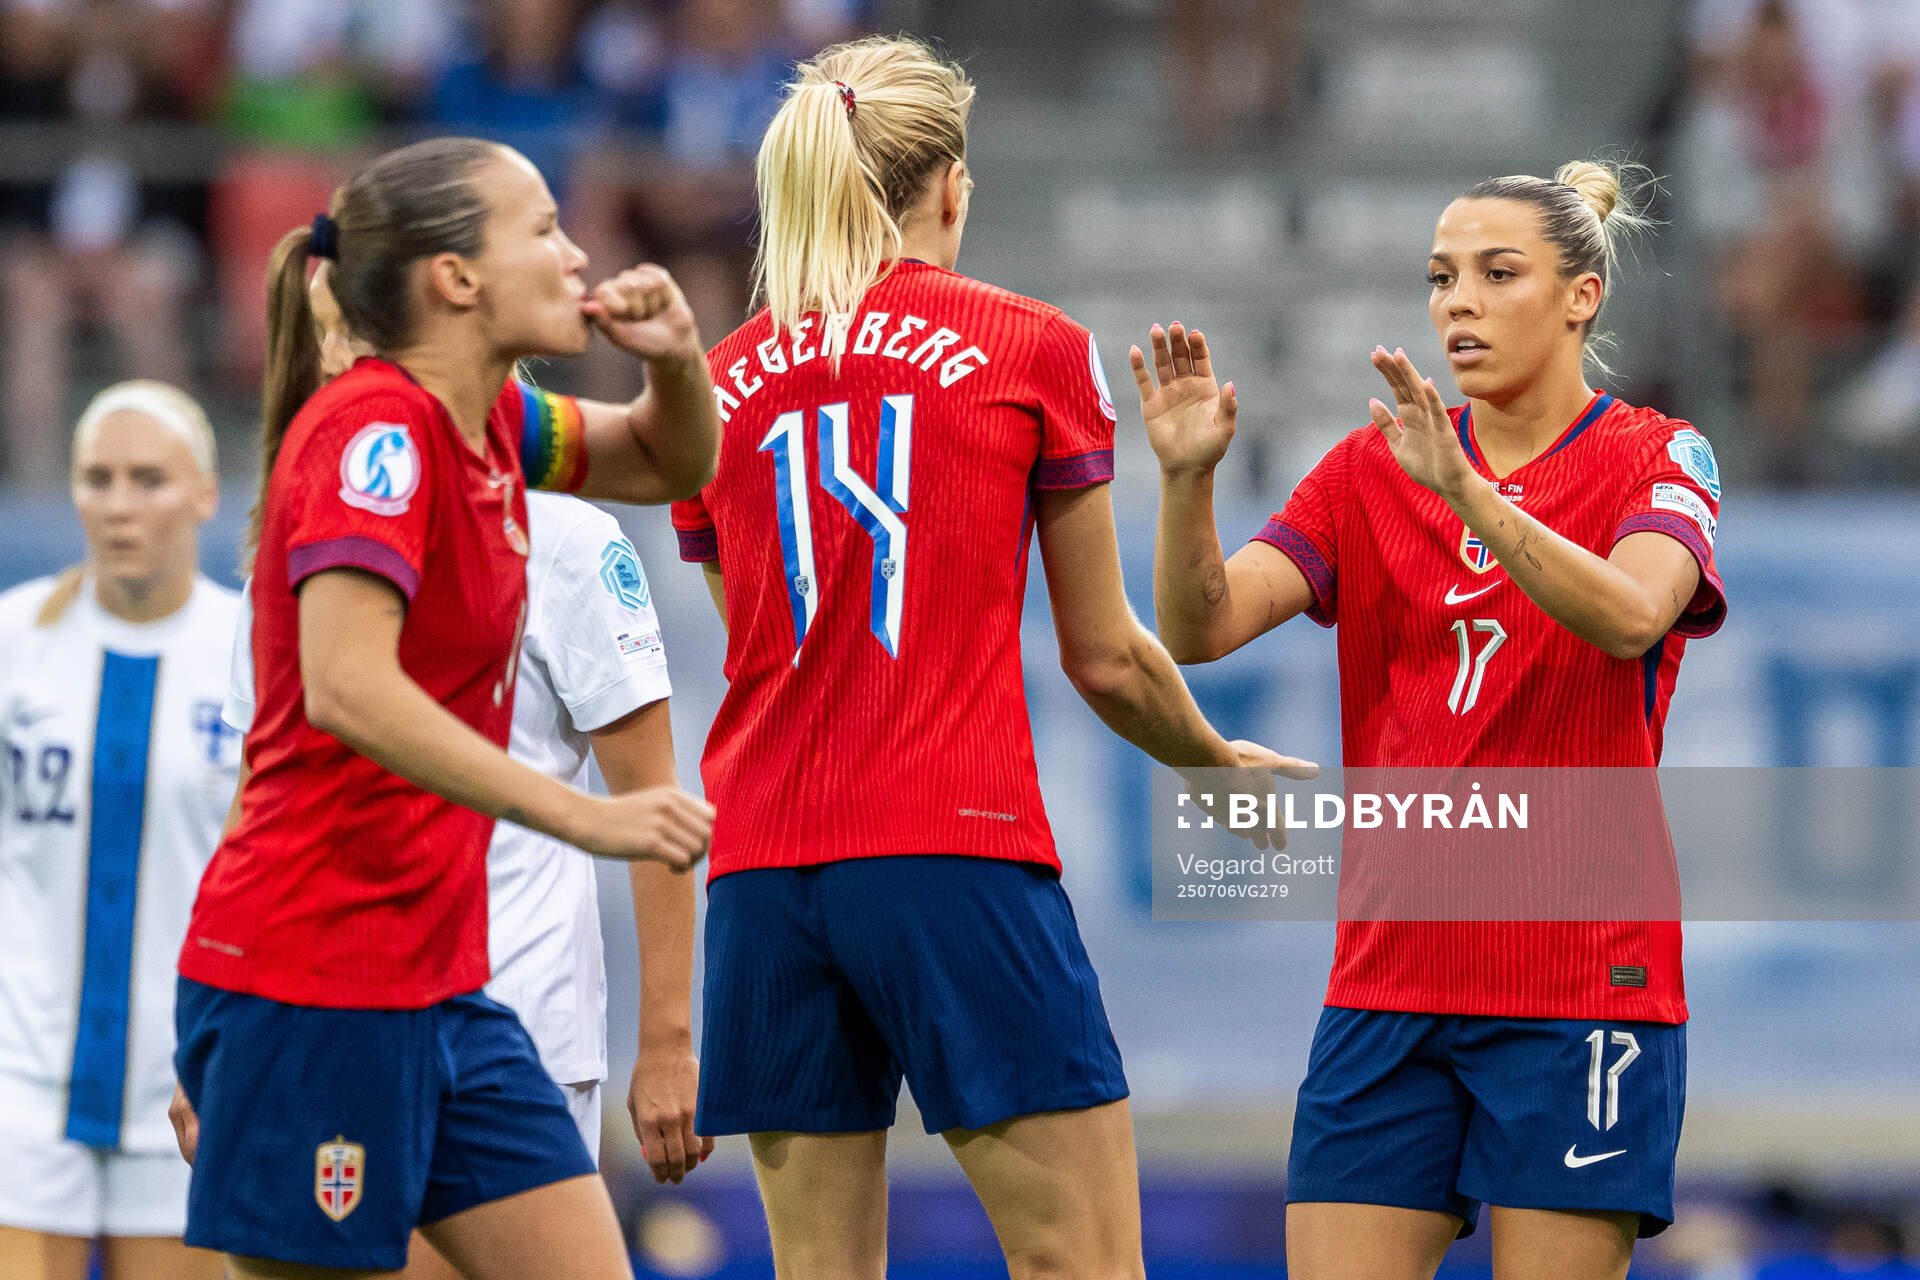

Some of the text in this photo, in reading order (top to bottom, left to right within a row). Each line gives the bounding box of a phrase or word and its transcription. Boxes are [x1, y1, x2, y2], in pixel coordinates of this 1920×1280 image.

[758, 394, 914, 668] 14
[1507, 484, 1523, 493] FIN
[1447, 619, 1507, 716] 17
[1585, 1030, 1641, 1131] 17
